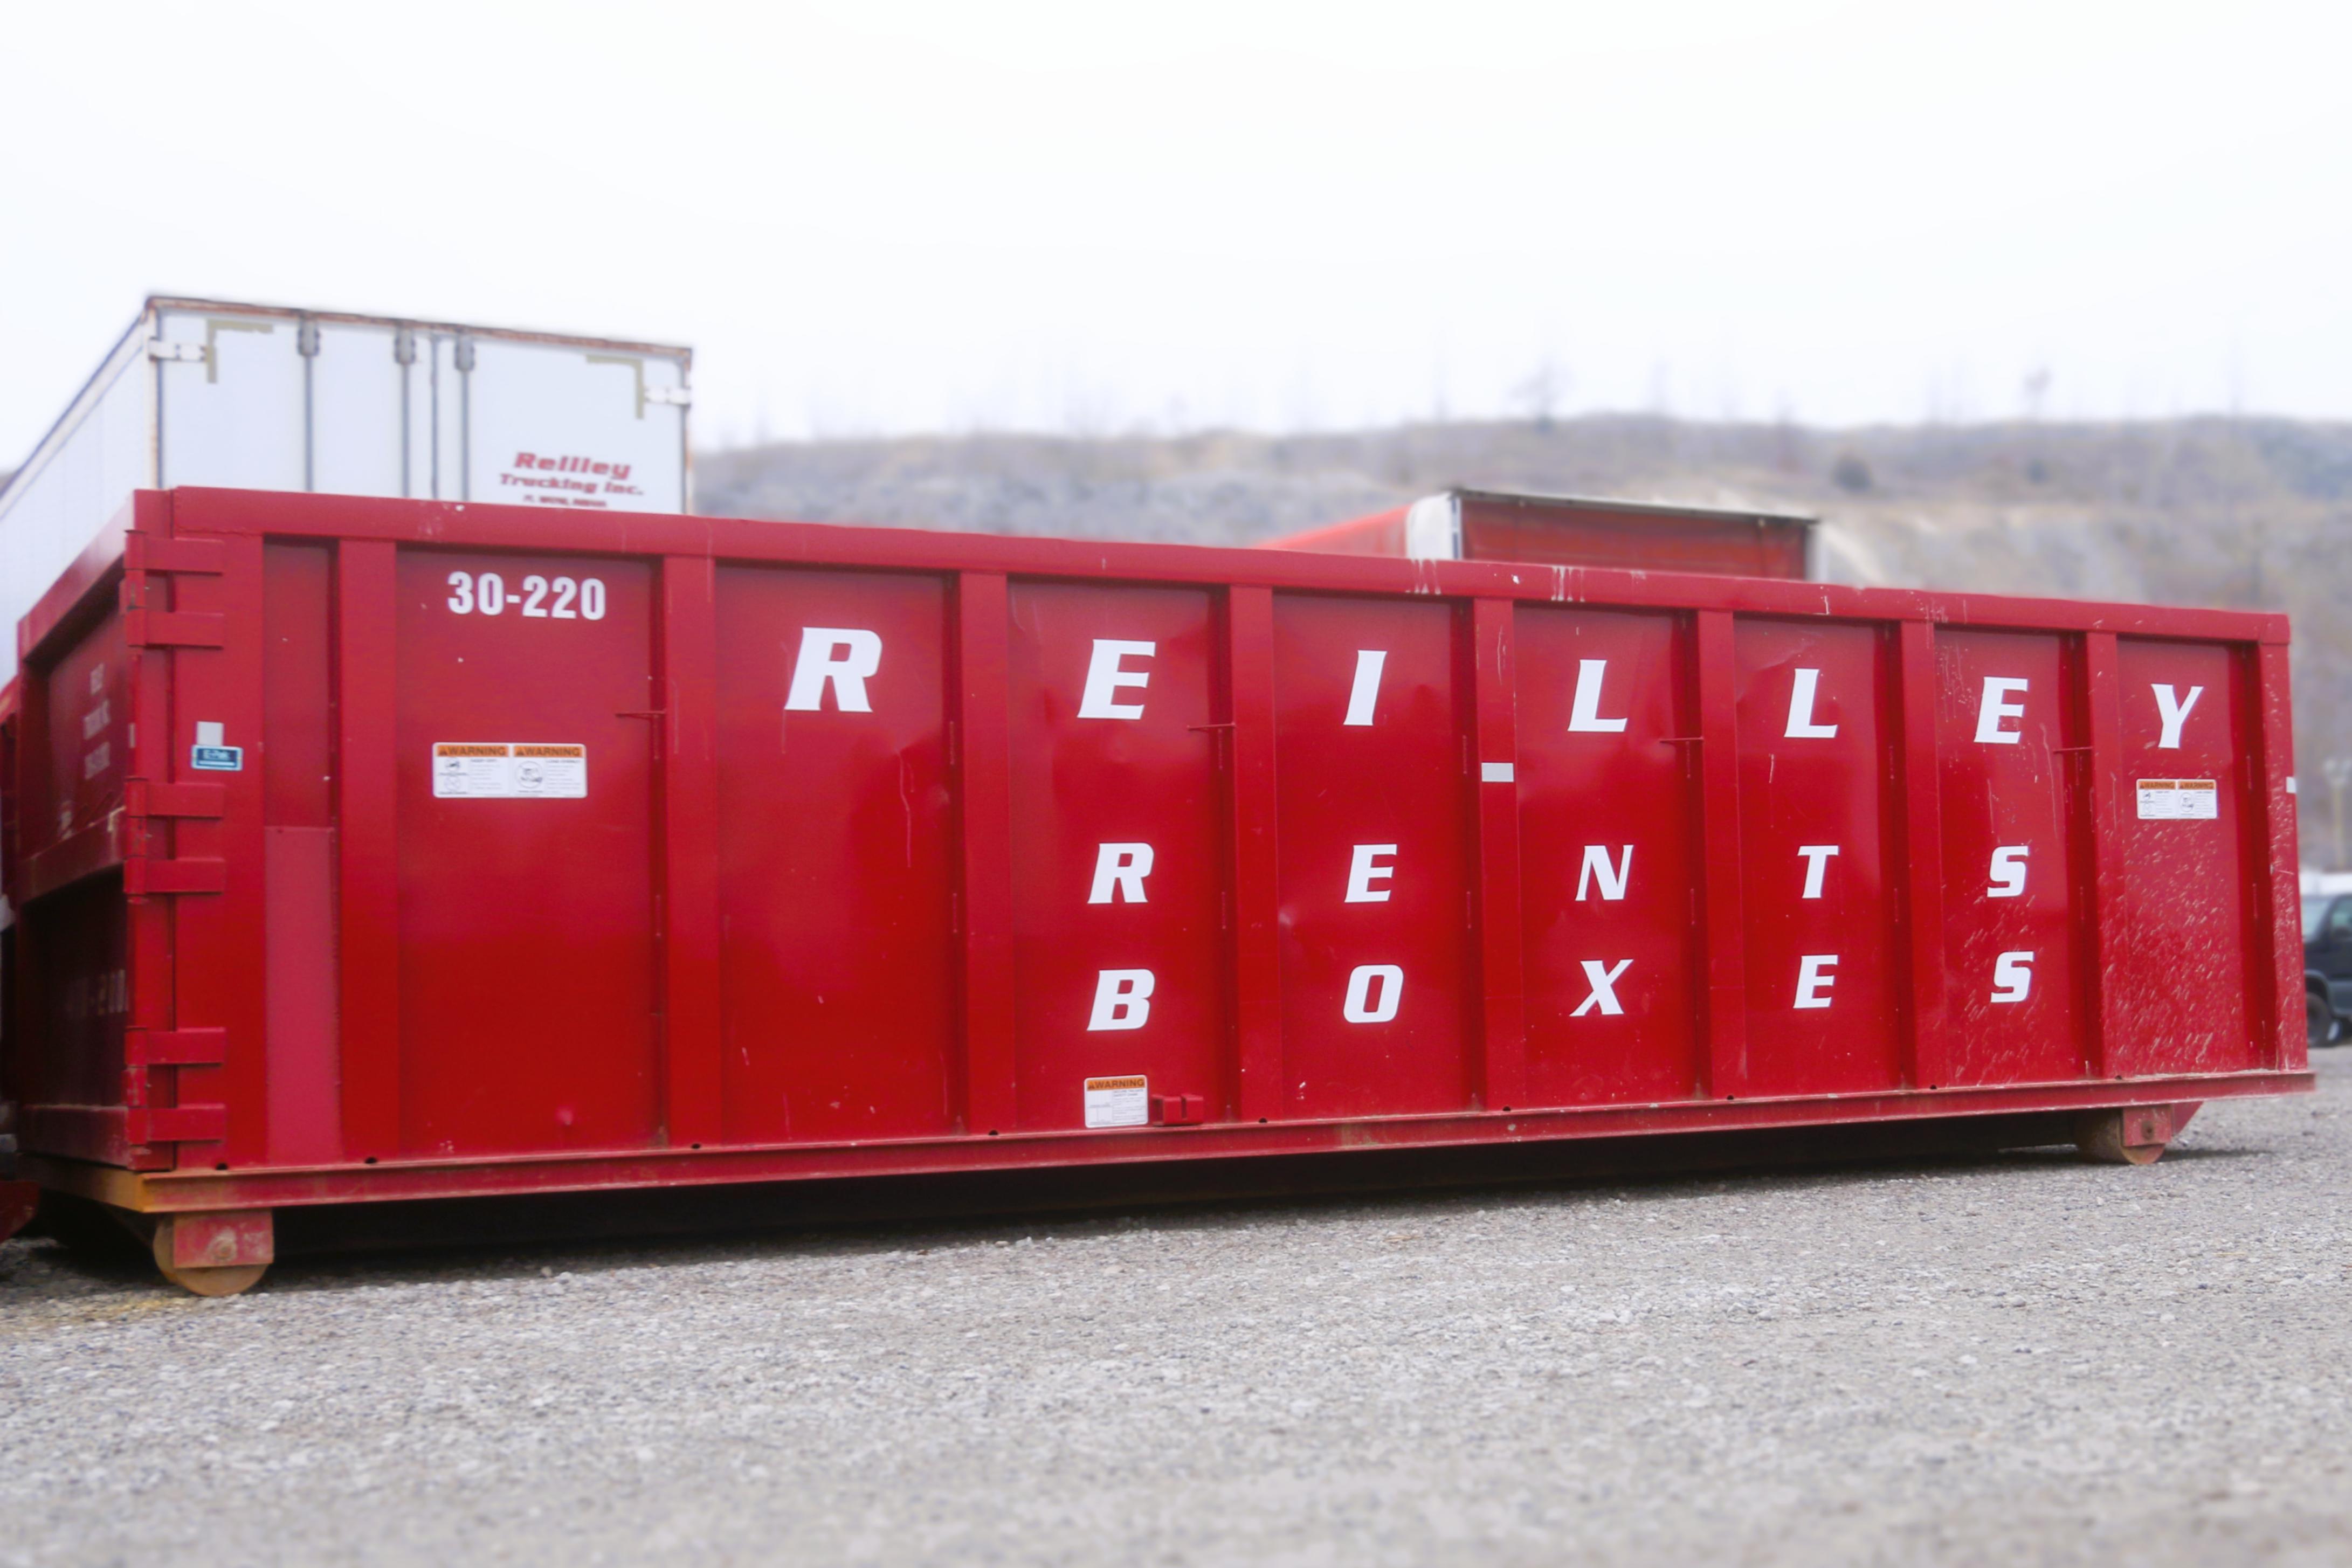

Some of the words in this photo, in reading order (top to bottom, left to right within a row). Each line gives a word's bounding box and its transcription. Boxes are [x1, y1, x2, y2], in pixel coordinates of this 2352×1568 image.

[500, 473, 597, 494] Trucking
[447, 570, 606, 621] 30-220
[447, 746, 506, 756] WARNING
[524, 747, 580, 757] WARNING
[1095, 1079, 1144, 1089] WARNING
